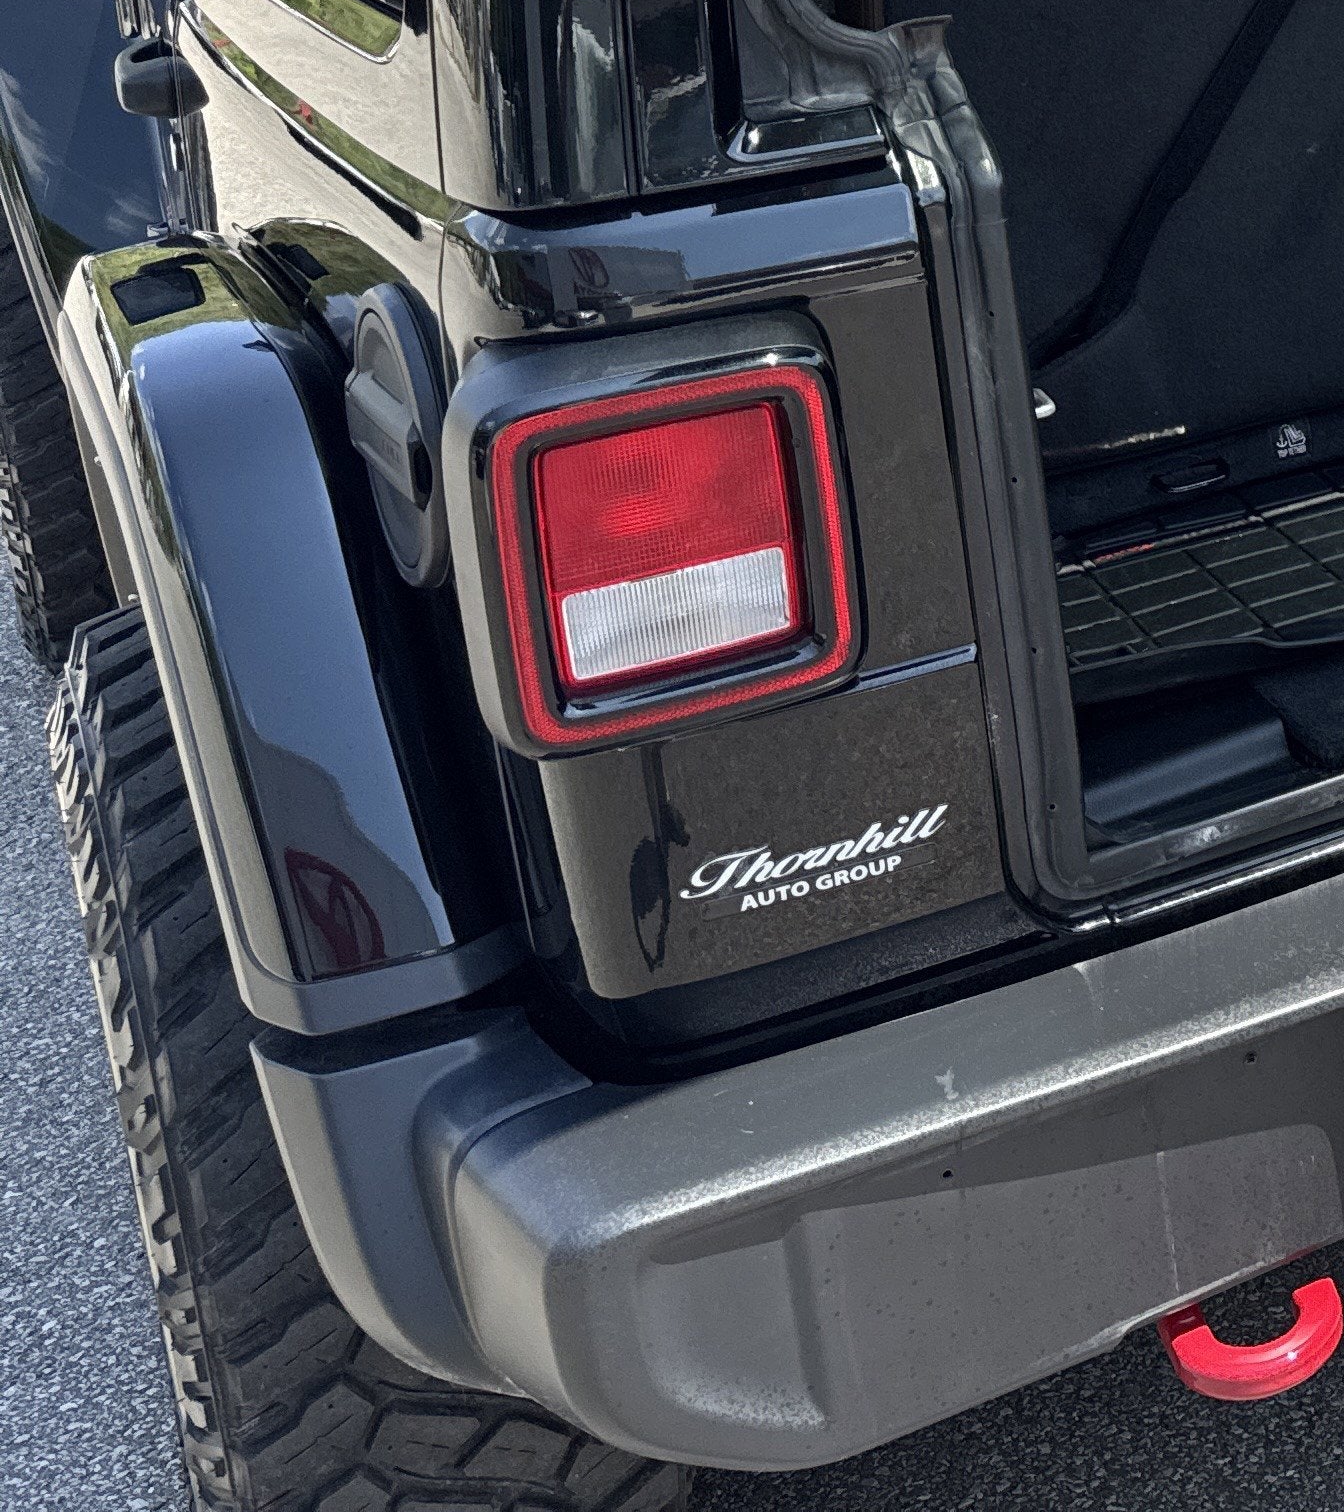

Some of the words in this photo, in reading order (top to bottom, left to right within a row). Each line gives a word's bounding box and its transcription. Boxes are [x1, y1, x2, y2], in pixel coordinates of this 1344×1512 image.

[680, 803, 949, 899] Thornhill
[740, 880, 810, 911] AUTO
[815, 855, 902, 891] GROUP
